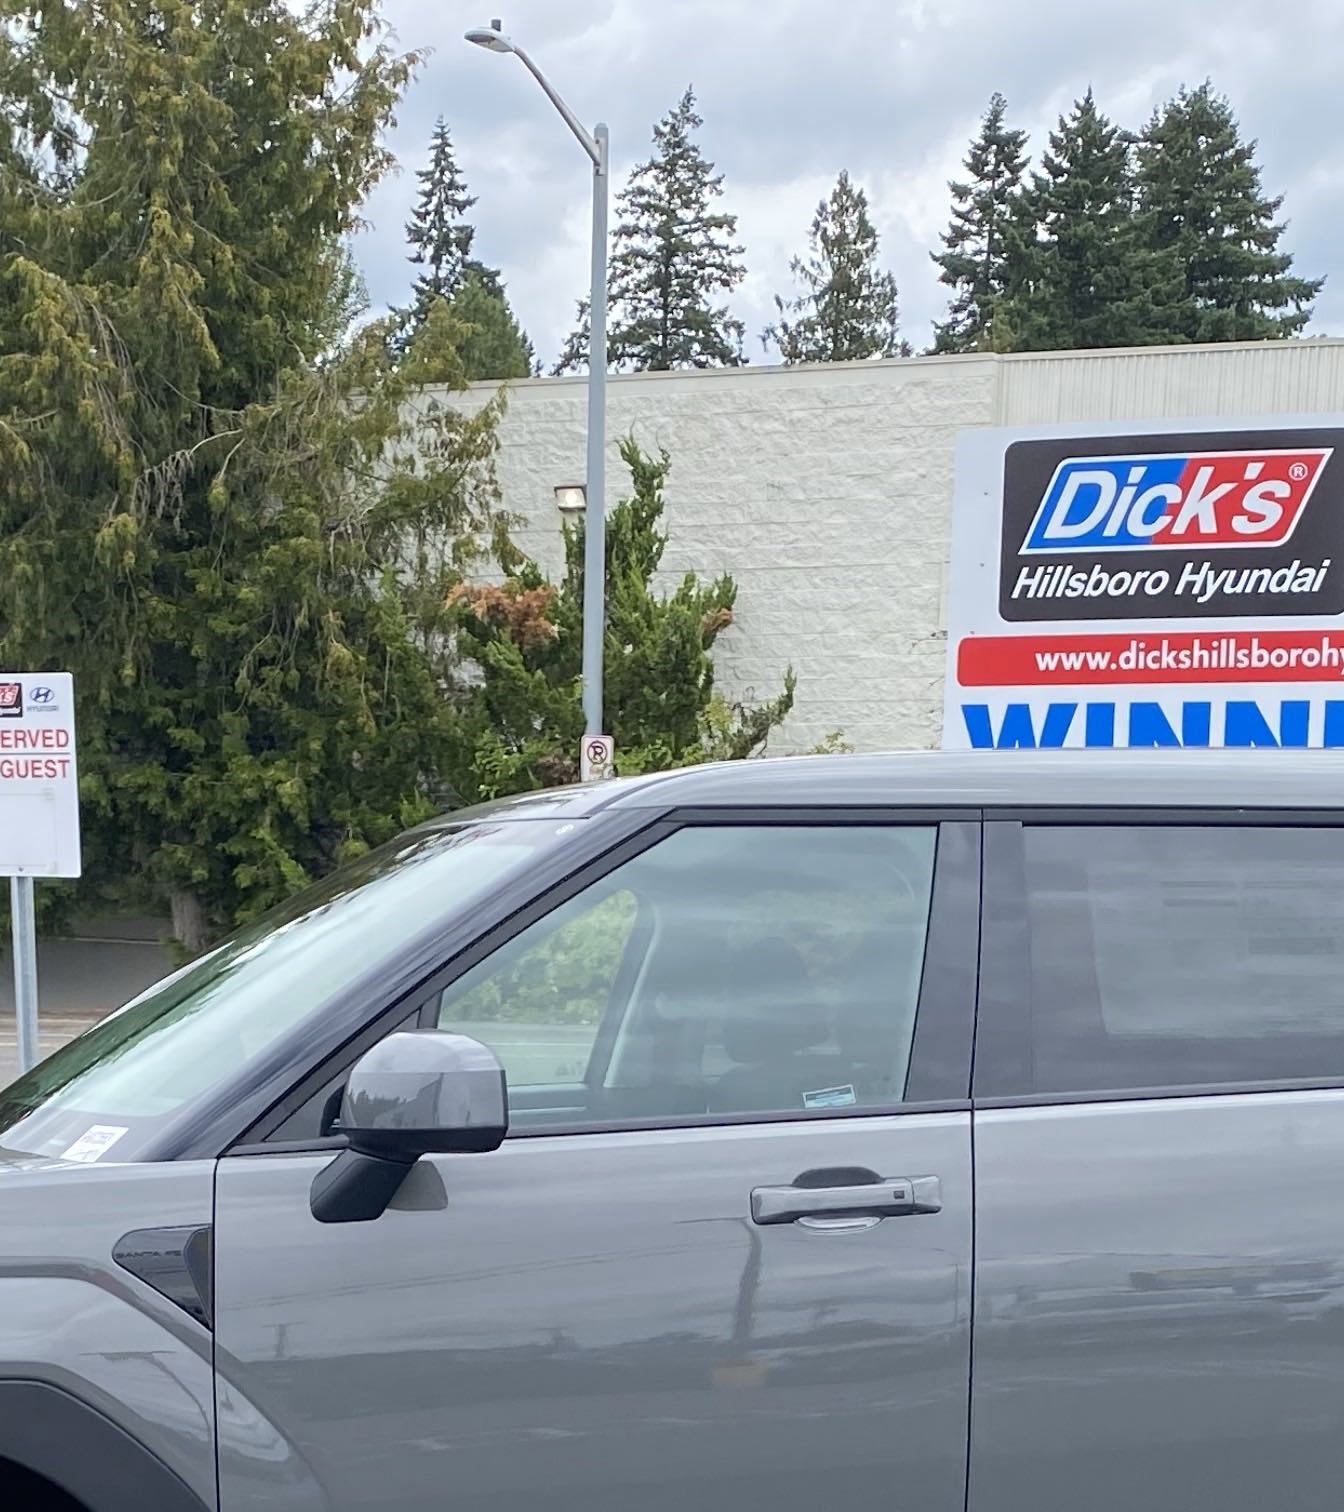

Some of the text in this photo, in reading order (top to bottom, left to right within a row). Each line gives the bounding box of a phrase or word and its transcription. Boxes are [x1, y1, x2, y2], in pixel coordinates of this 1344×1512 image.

[1011, 559, 1331, 602] Hillsboro Hyundai
[0, 760, 70, 779] GUEST
